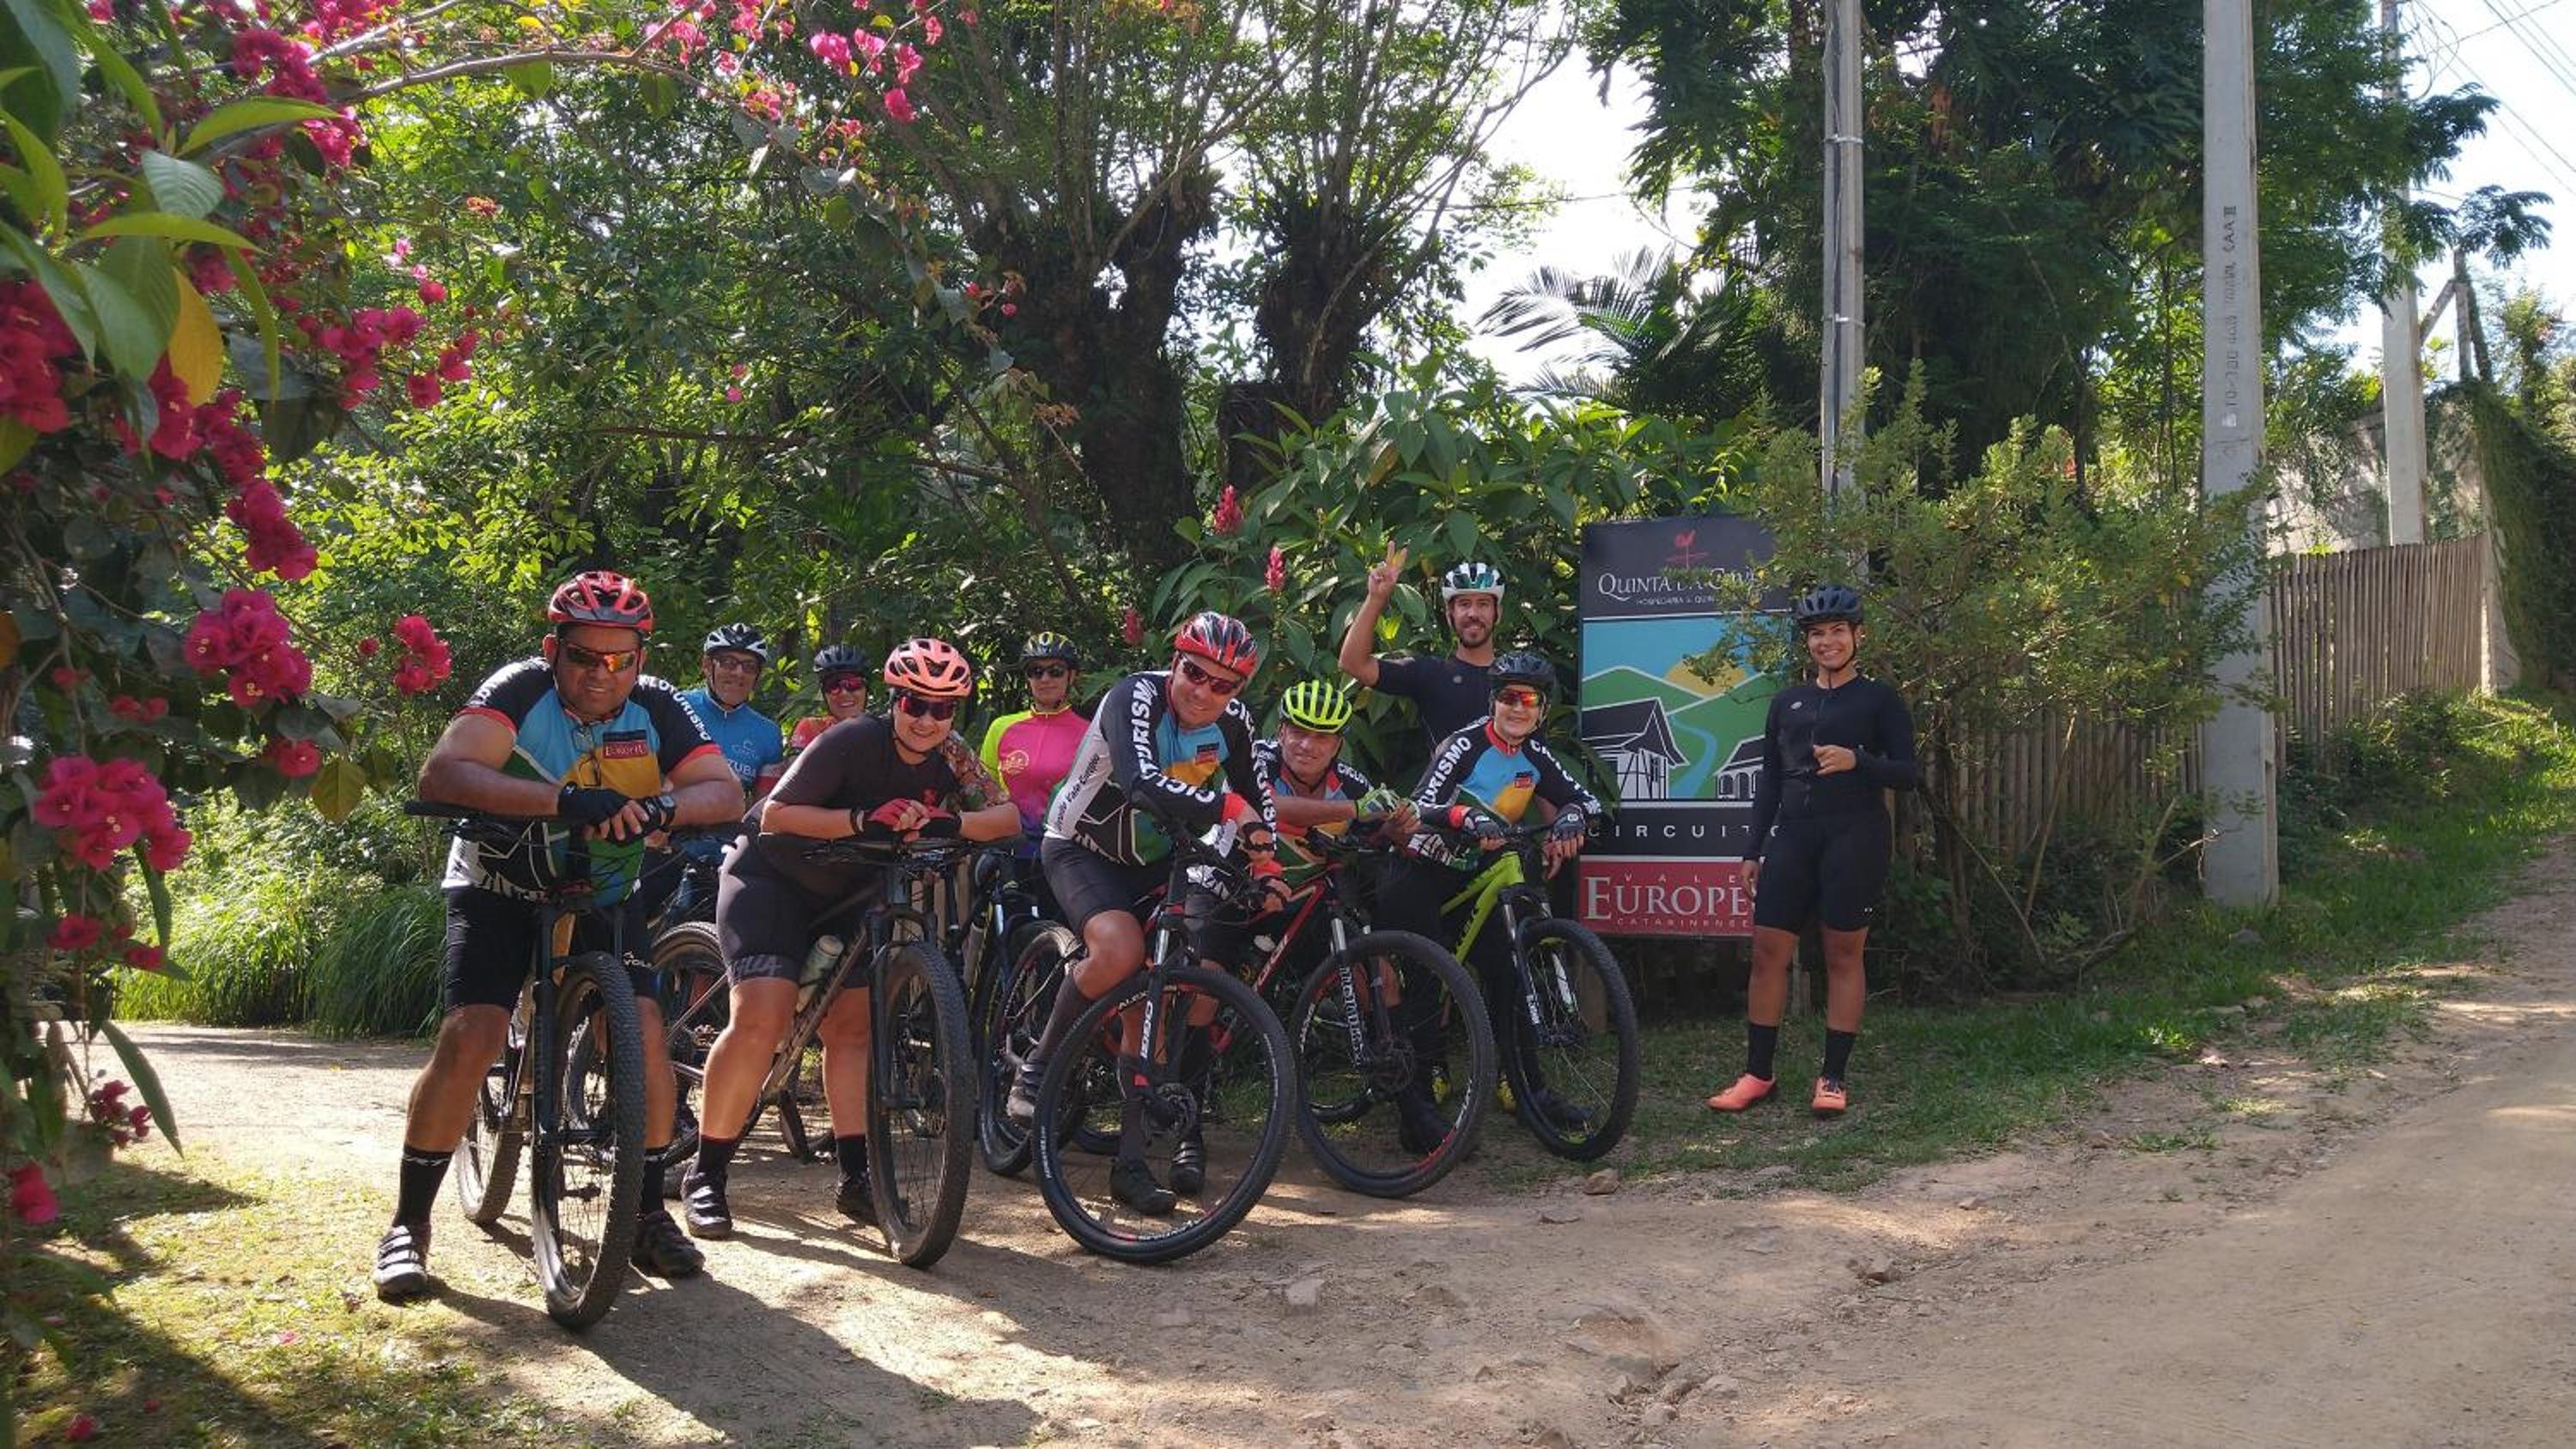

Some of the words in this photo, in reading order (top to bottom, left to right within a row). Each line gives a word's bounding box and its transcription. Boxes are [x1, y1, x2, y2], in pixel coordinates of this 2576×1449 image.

[1598, 573, 1672, 601] QUINTA
[1624, 873, 1735, 883] VALE
[1585, 876, 1756, 920] EUROPE
